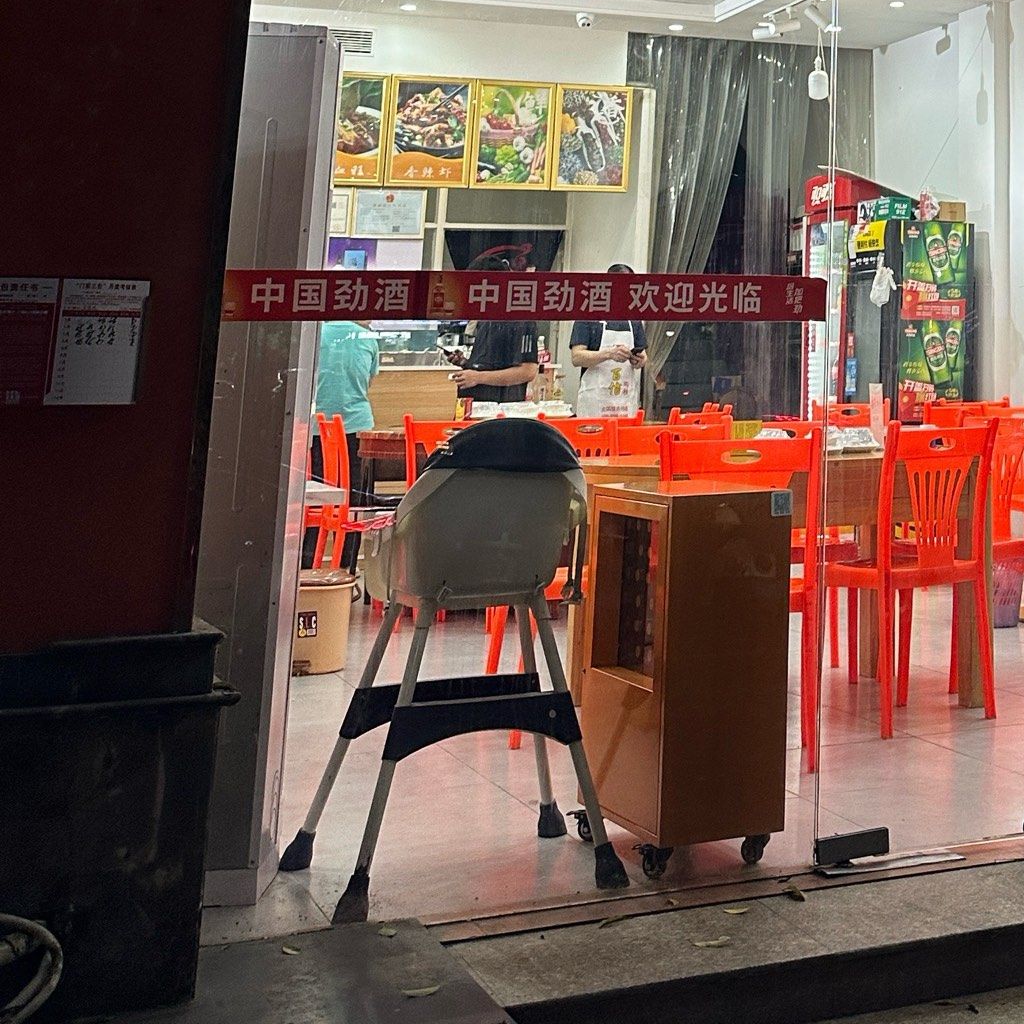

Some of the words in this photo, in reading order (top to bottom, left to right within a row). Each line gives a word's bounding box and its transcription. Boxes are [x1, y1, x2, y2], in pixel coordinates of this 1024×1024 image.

[250, 277, 411, 313] 中国劲酒
[467, 278, 613, 313] 中国劲酒
[628, 281, 763, 314] 欢迎光临
